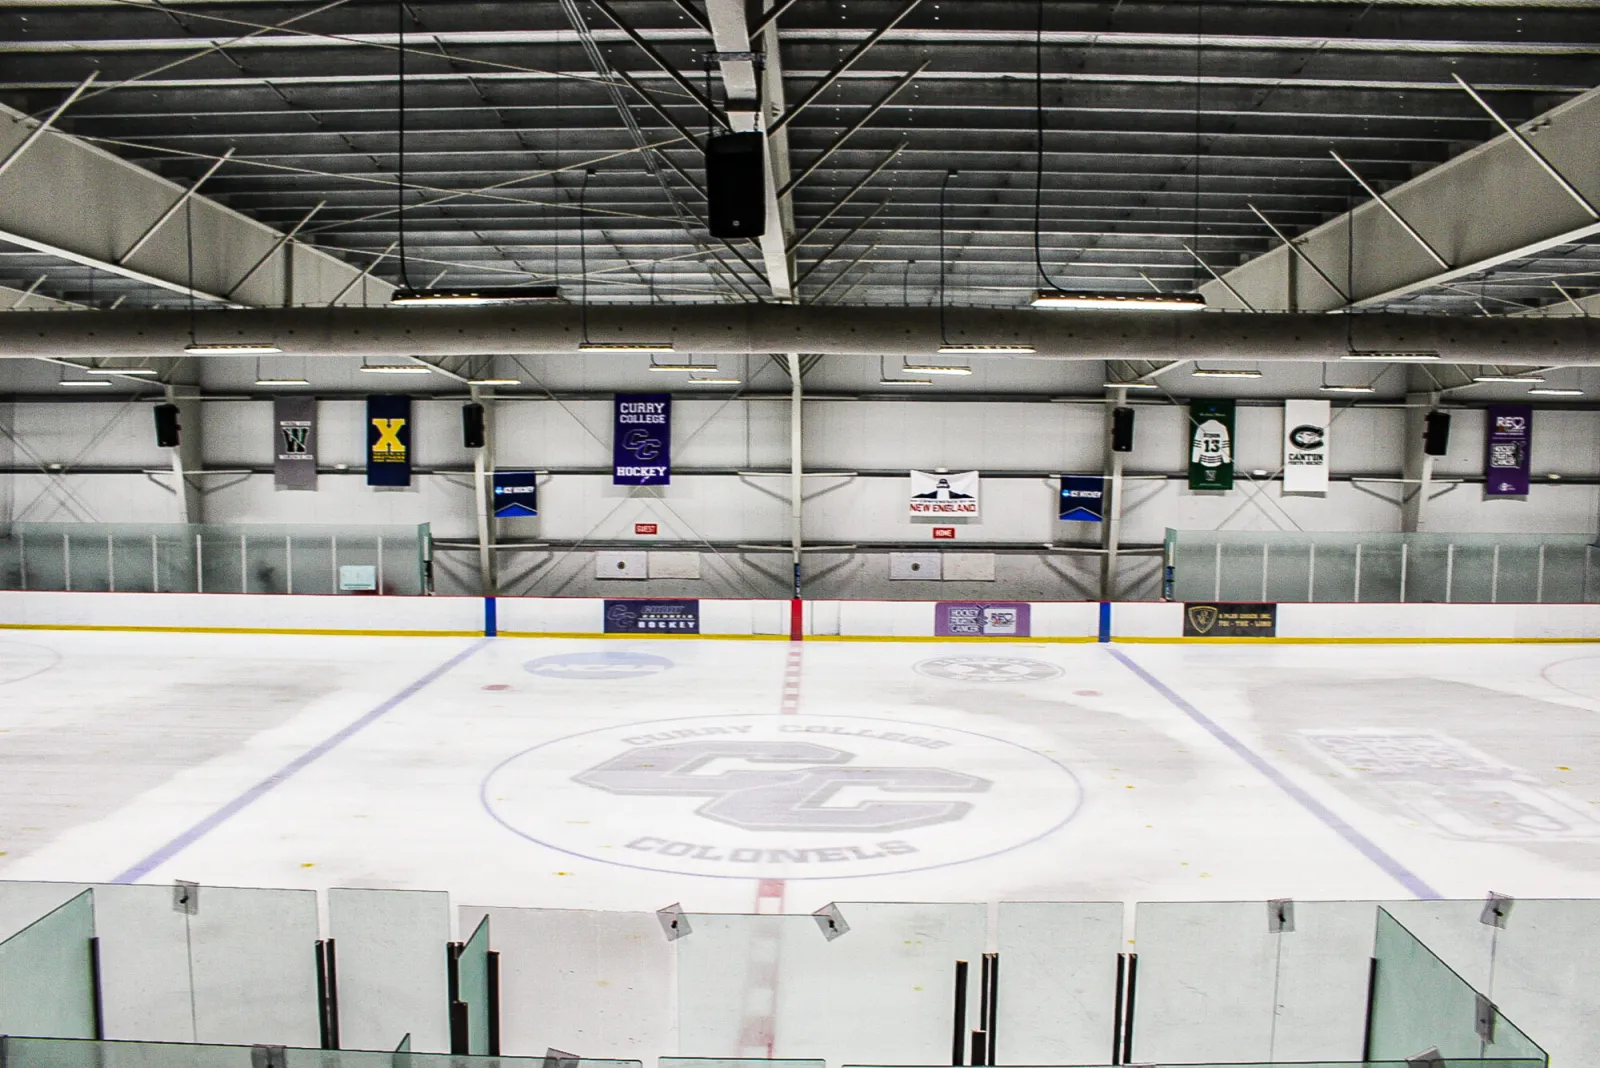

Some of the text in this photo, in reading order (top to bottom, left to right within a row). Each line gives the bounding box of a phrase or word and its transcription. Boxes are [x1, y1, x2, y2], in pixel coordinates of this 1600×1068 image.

[620, 403, 665, 413] CURRY
[620, 414, 666, 423] COLLEGE
[372, 418, 406, 452] X
[1203, 440, 1220, 452] 13
[1288, 453, 1324, 461] CANTON
[617, 467, 667, 477] HOCKEY
[910, 503, 976, 512] NEW ENGLAND
[935, 529, 953, 537] HOME
[620, 724, 953, 749] CURRY COLLEGE
[624, 836, 920, 864] COLONELS
